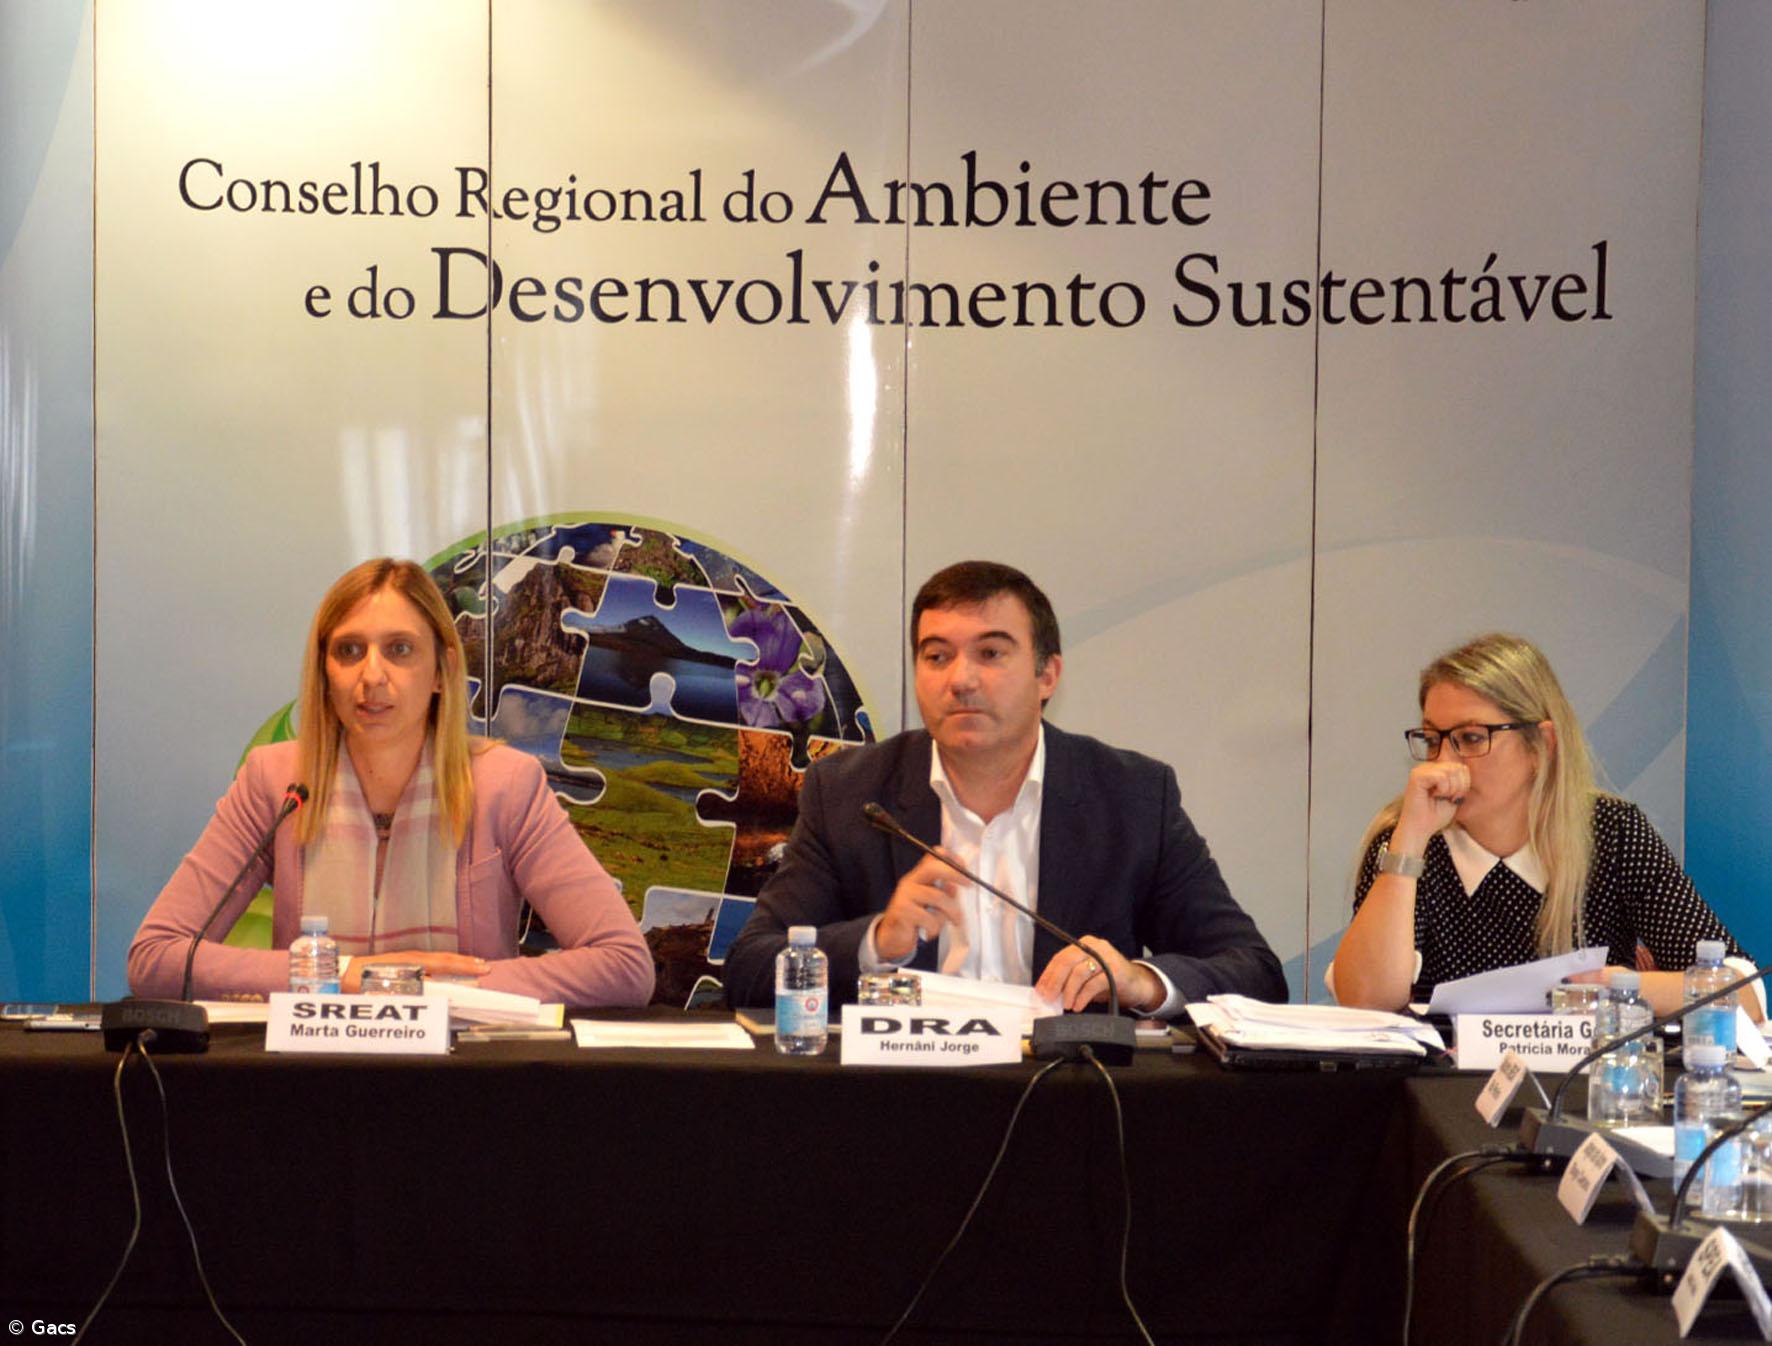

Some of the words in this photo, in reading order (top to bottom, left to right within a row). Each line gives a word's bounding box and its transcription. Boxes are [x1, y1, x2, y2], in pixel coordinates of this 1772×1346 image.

[179, 157, 438, 217] Conselho
[455, 166, 706, 232] Regional
[722, 170, 793, 223] do
[806, 149, 1212, 227] Ambiente
[305, 284, 331, 318] e
[347, 266, 415, 319] do
[432, 246, 1146, 327] Desenvolvimento
[1173, 241, 1613, 327] Sustentável
[292, 1002, 428, 1021] SREAT
[290, 1023, 339, 1038] Marta
[345, 1024, 426, 1039] Guerreiro
[861, 1017, 1001, 1036] DRA
[1482, 1019, 1573, 1039] Secretária
[880, 1040, 935, 1052] Hernâni
[940, 1042, 980, 1054] Jorge
